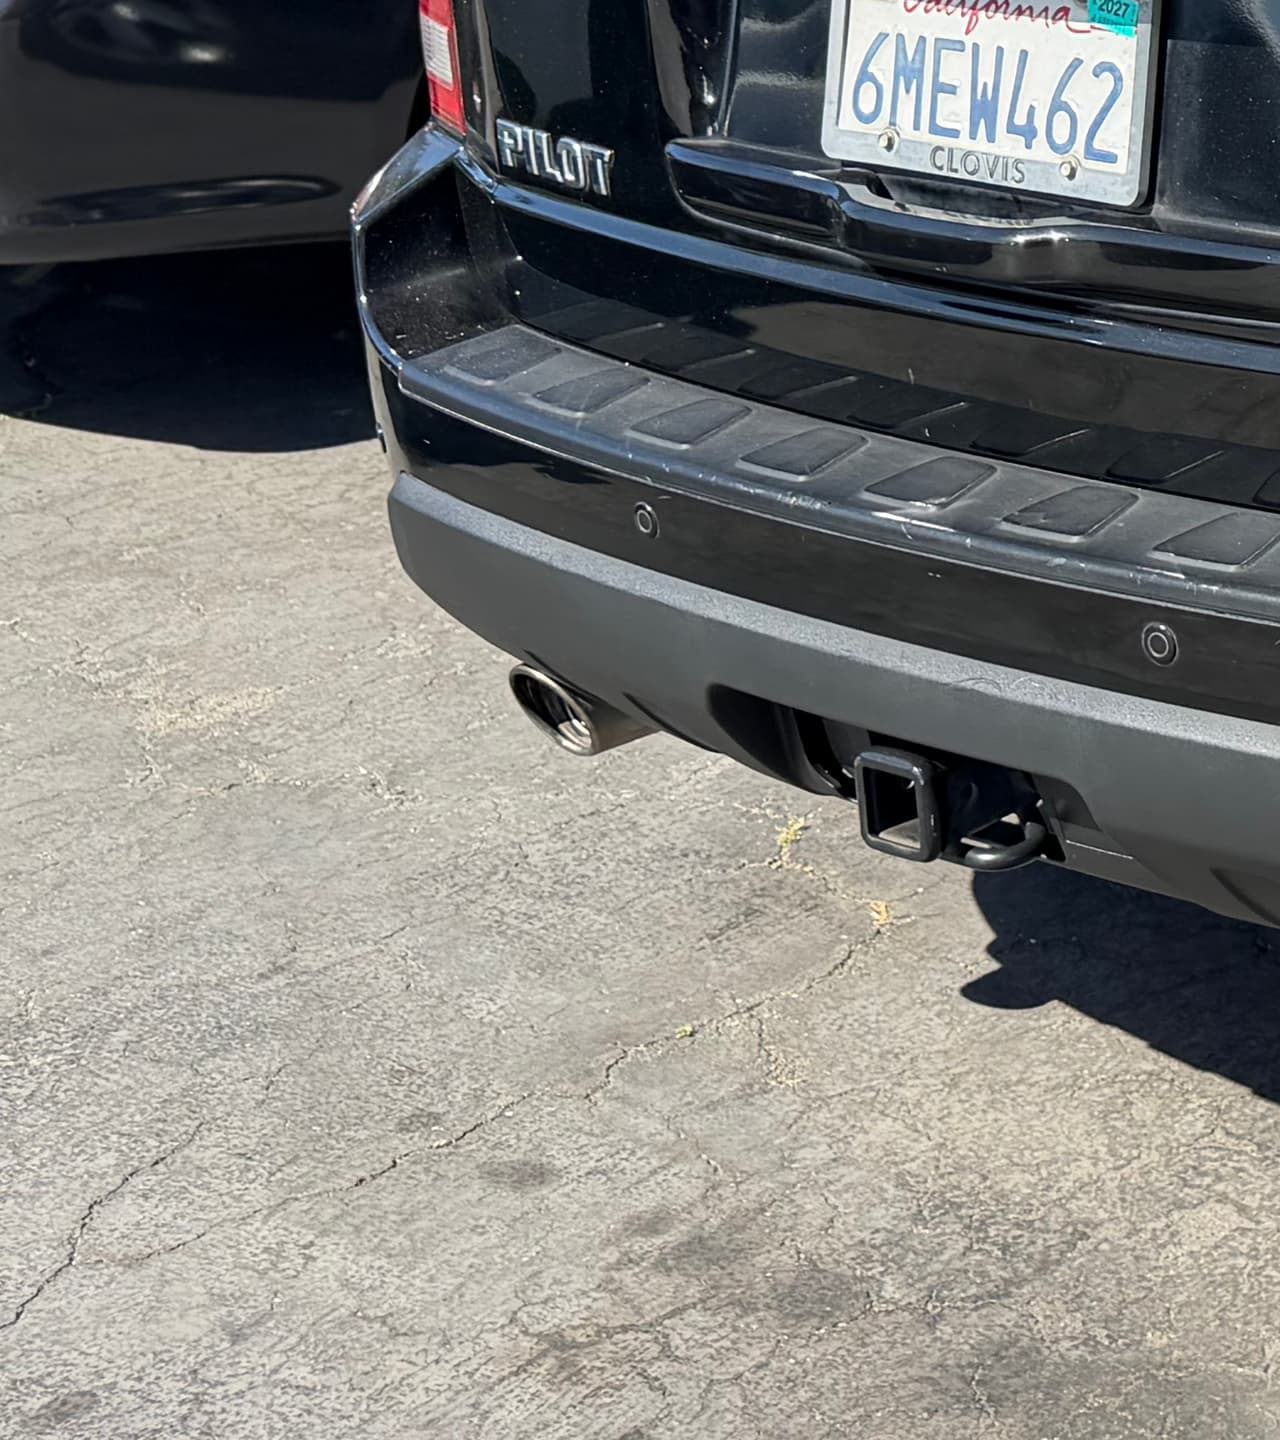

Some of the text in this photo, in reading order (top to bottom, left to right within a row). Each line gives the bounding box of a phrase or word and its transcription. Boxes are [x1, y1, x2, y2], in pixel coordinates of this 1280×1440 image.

[851, 31, 1125, 165] 6MEW462
[496, 117, 615, 196] PILOT
[929, 145, 1027, 185] CLOVIS
